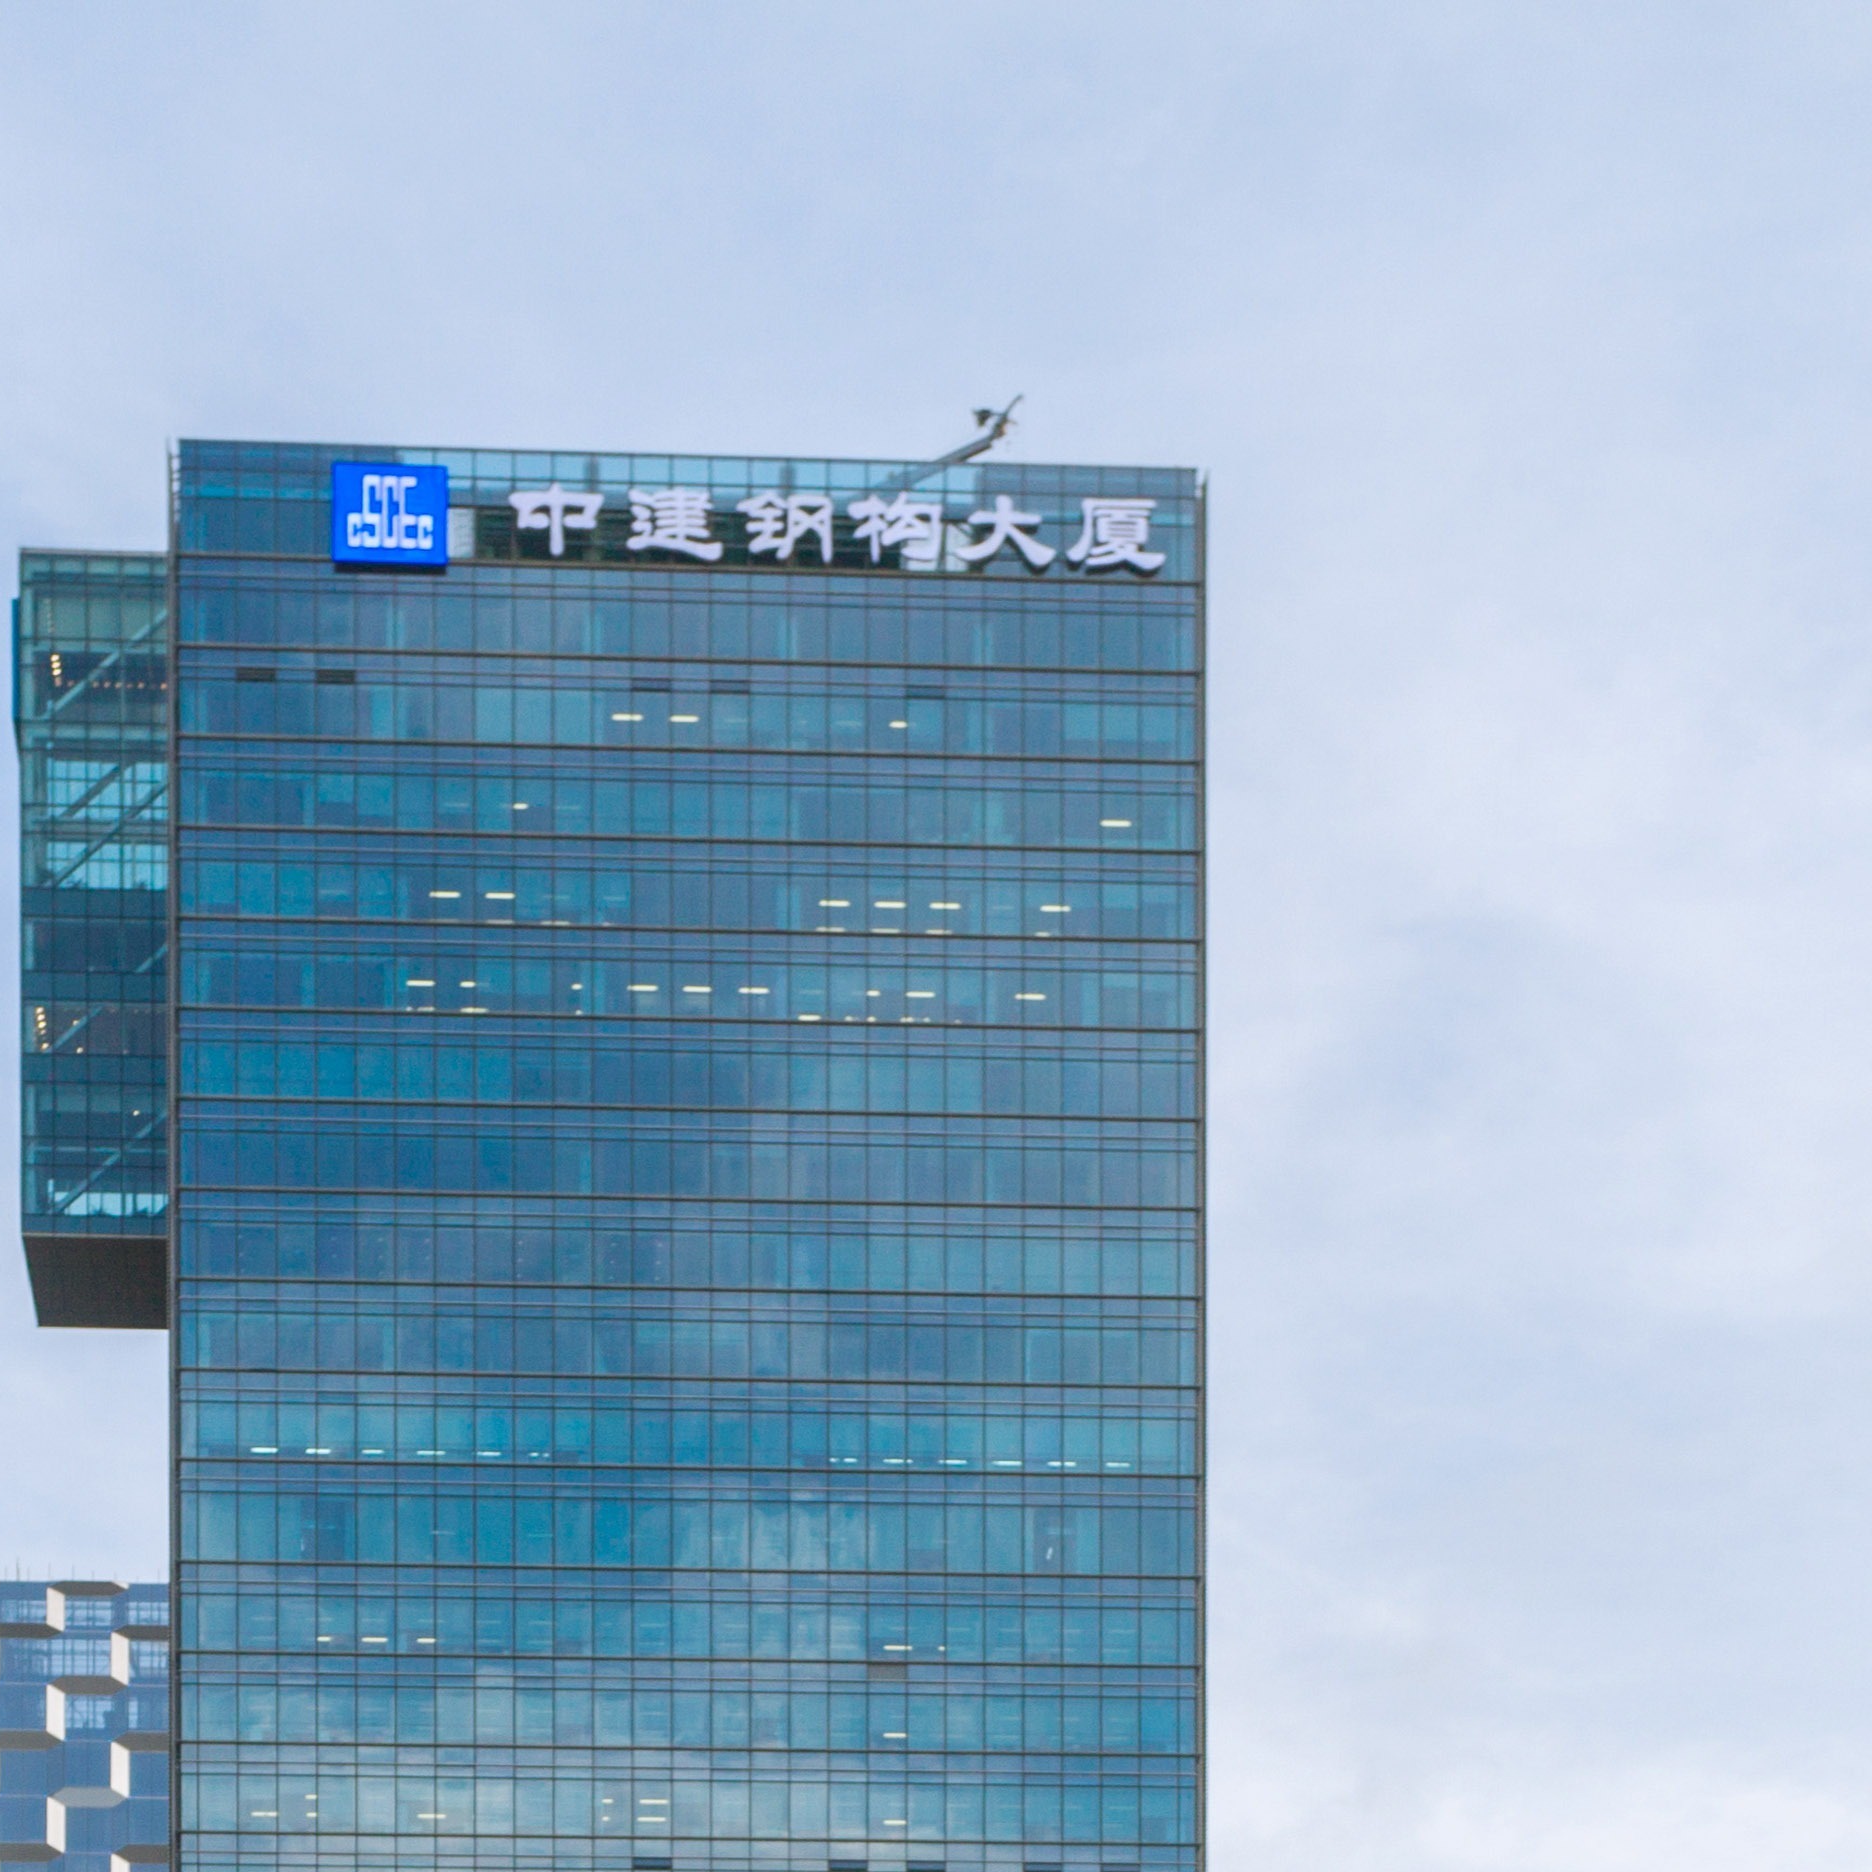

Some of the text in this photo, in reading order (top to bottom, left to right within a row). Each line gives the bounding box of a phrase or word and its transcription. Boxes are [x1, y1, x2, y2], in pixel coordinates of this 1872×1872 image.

[509, 481, 1166, 571] 中建钢构大厦
